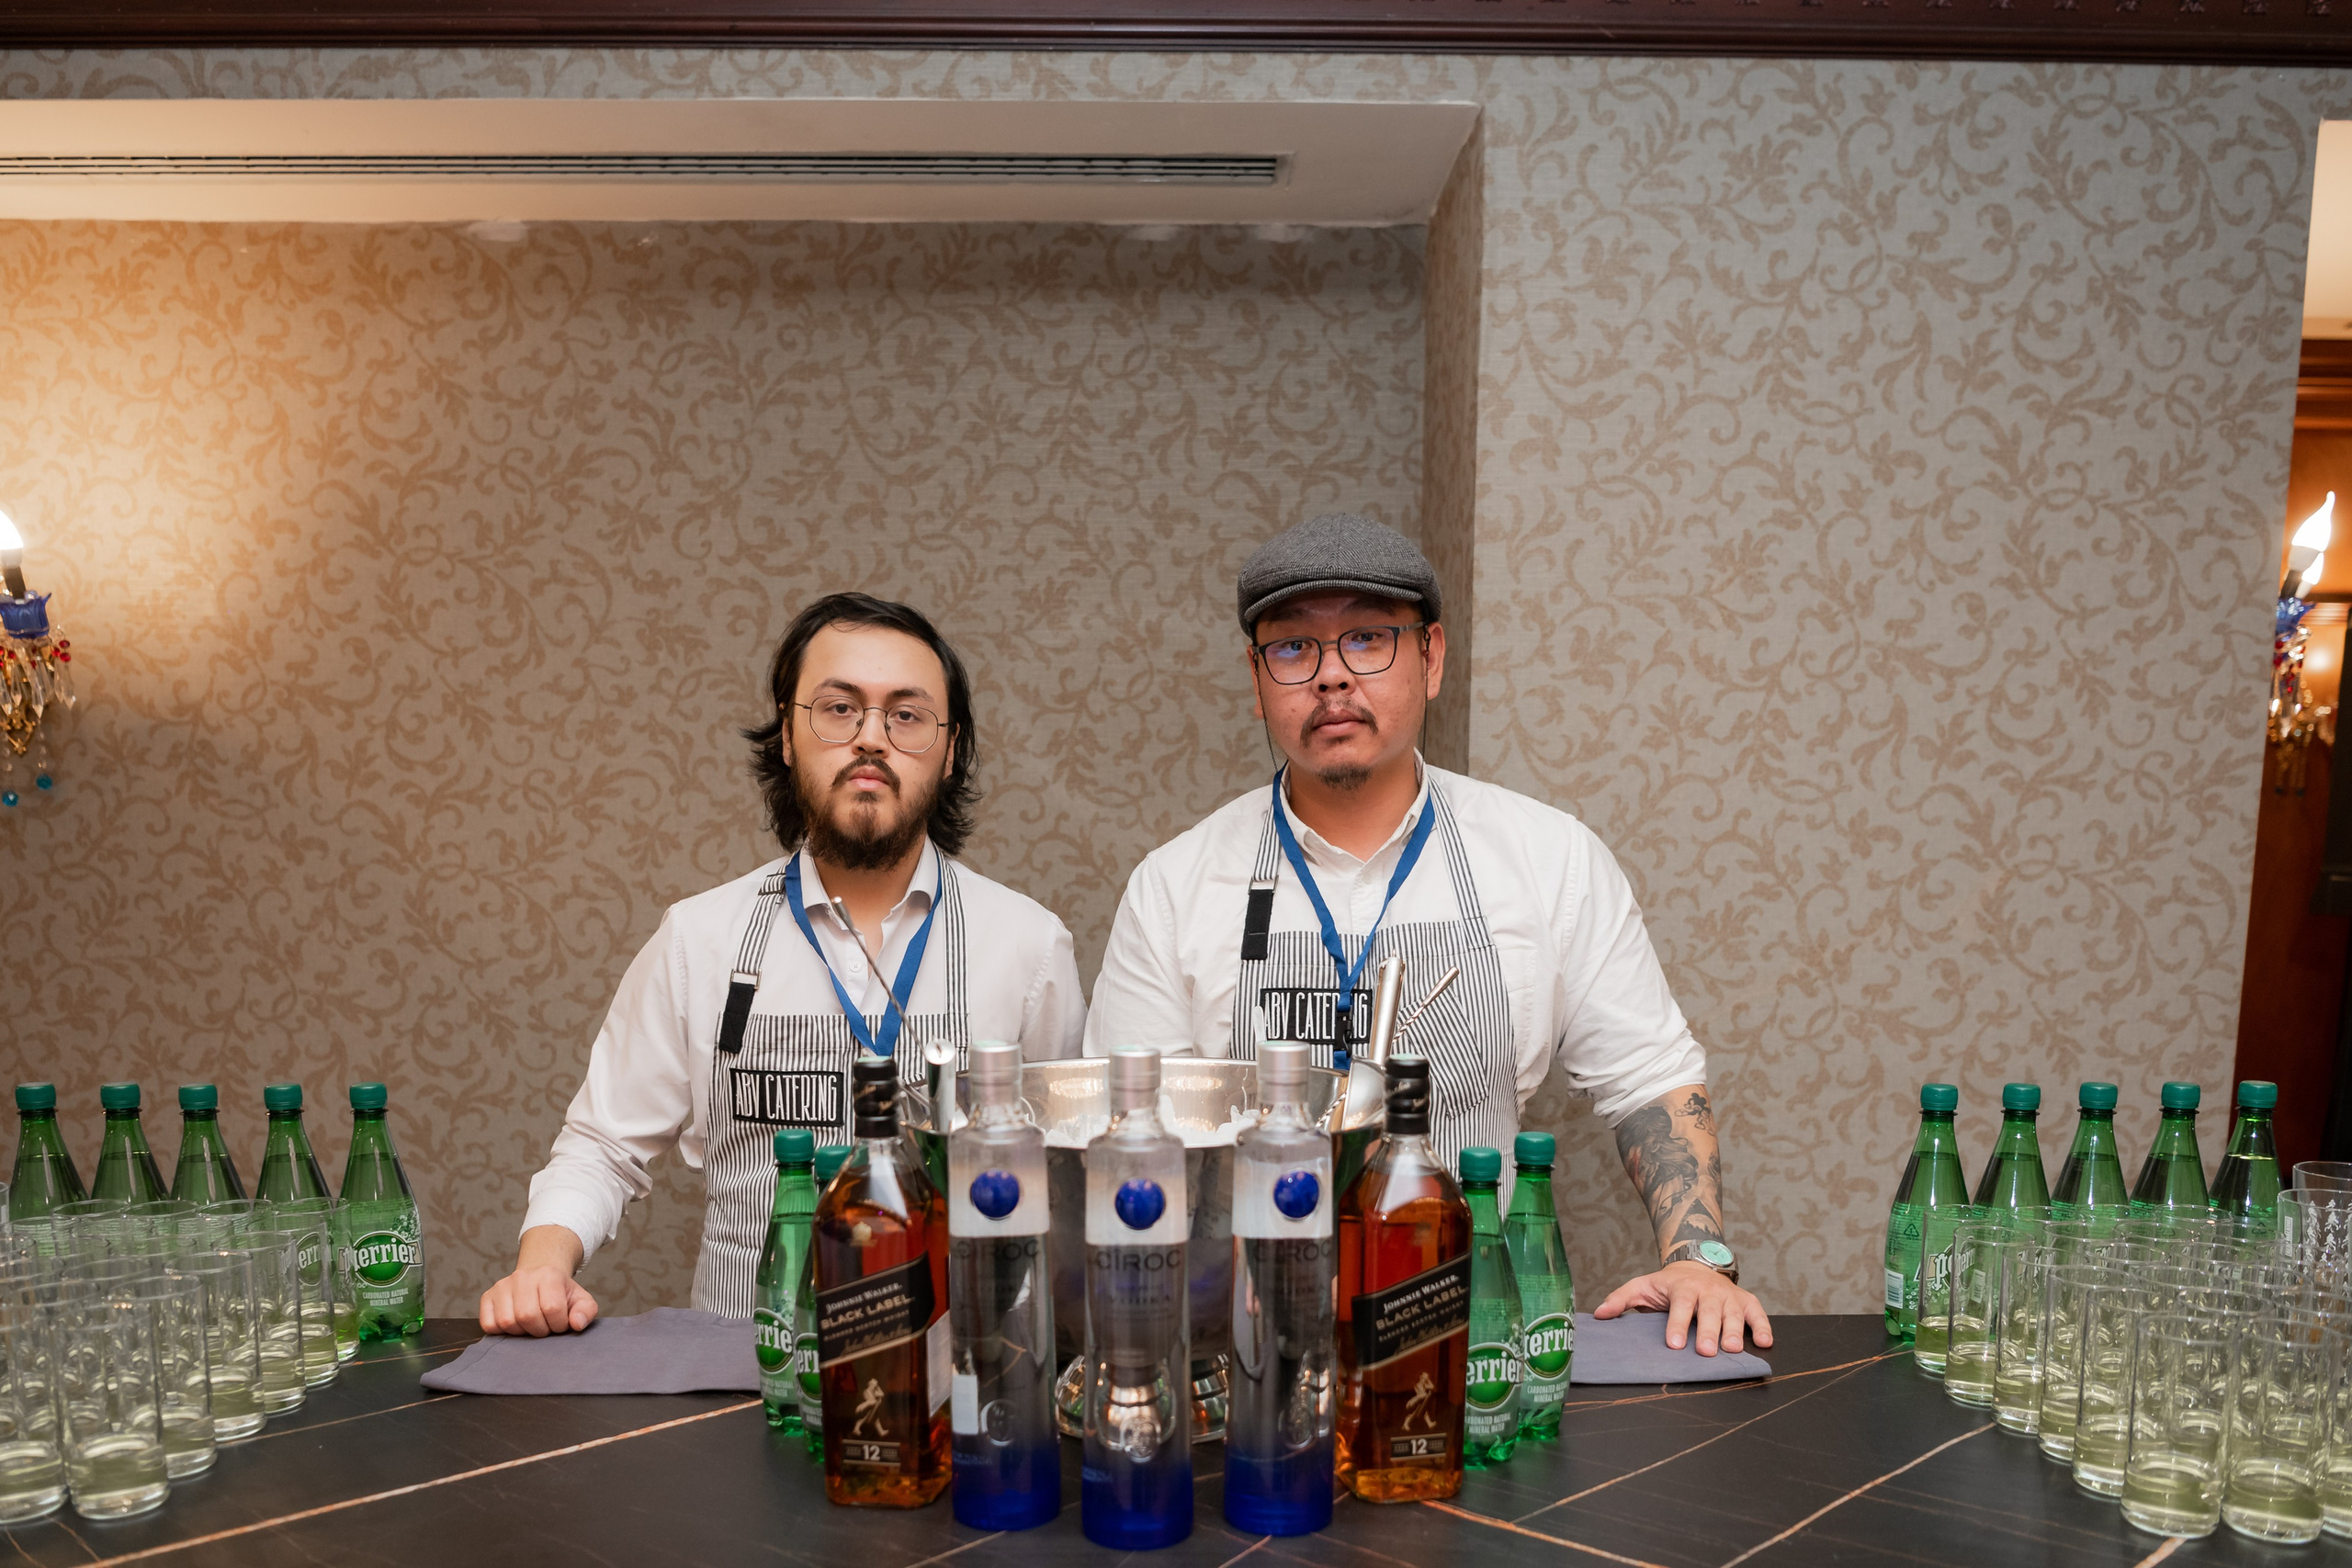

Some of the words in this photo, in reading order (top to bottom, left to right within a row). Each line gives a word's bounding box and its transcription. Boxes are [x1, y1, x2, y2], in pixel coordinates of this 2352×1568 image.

[1264, 992, 1290, 1039] ABV
[1295, 992, 1368, 1039] CATEG
[735, 1072, 760, 1119] ABV
[765, 1074, 837, 1121] CATERING
[820, 1307, 865, 1331] BLACK
[1375, 1303, 1421, 1331] BLACK
[1523, 1321, 1575, 1359] errie
[1465, 1351, 1521, 1385] errier
[863, 1444, 880, 1461] 12
[1410, 1438, 1428, 1455] 12
